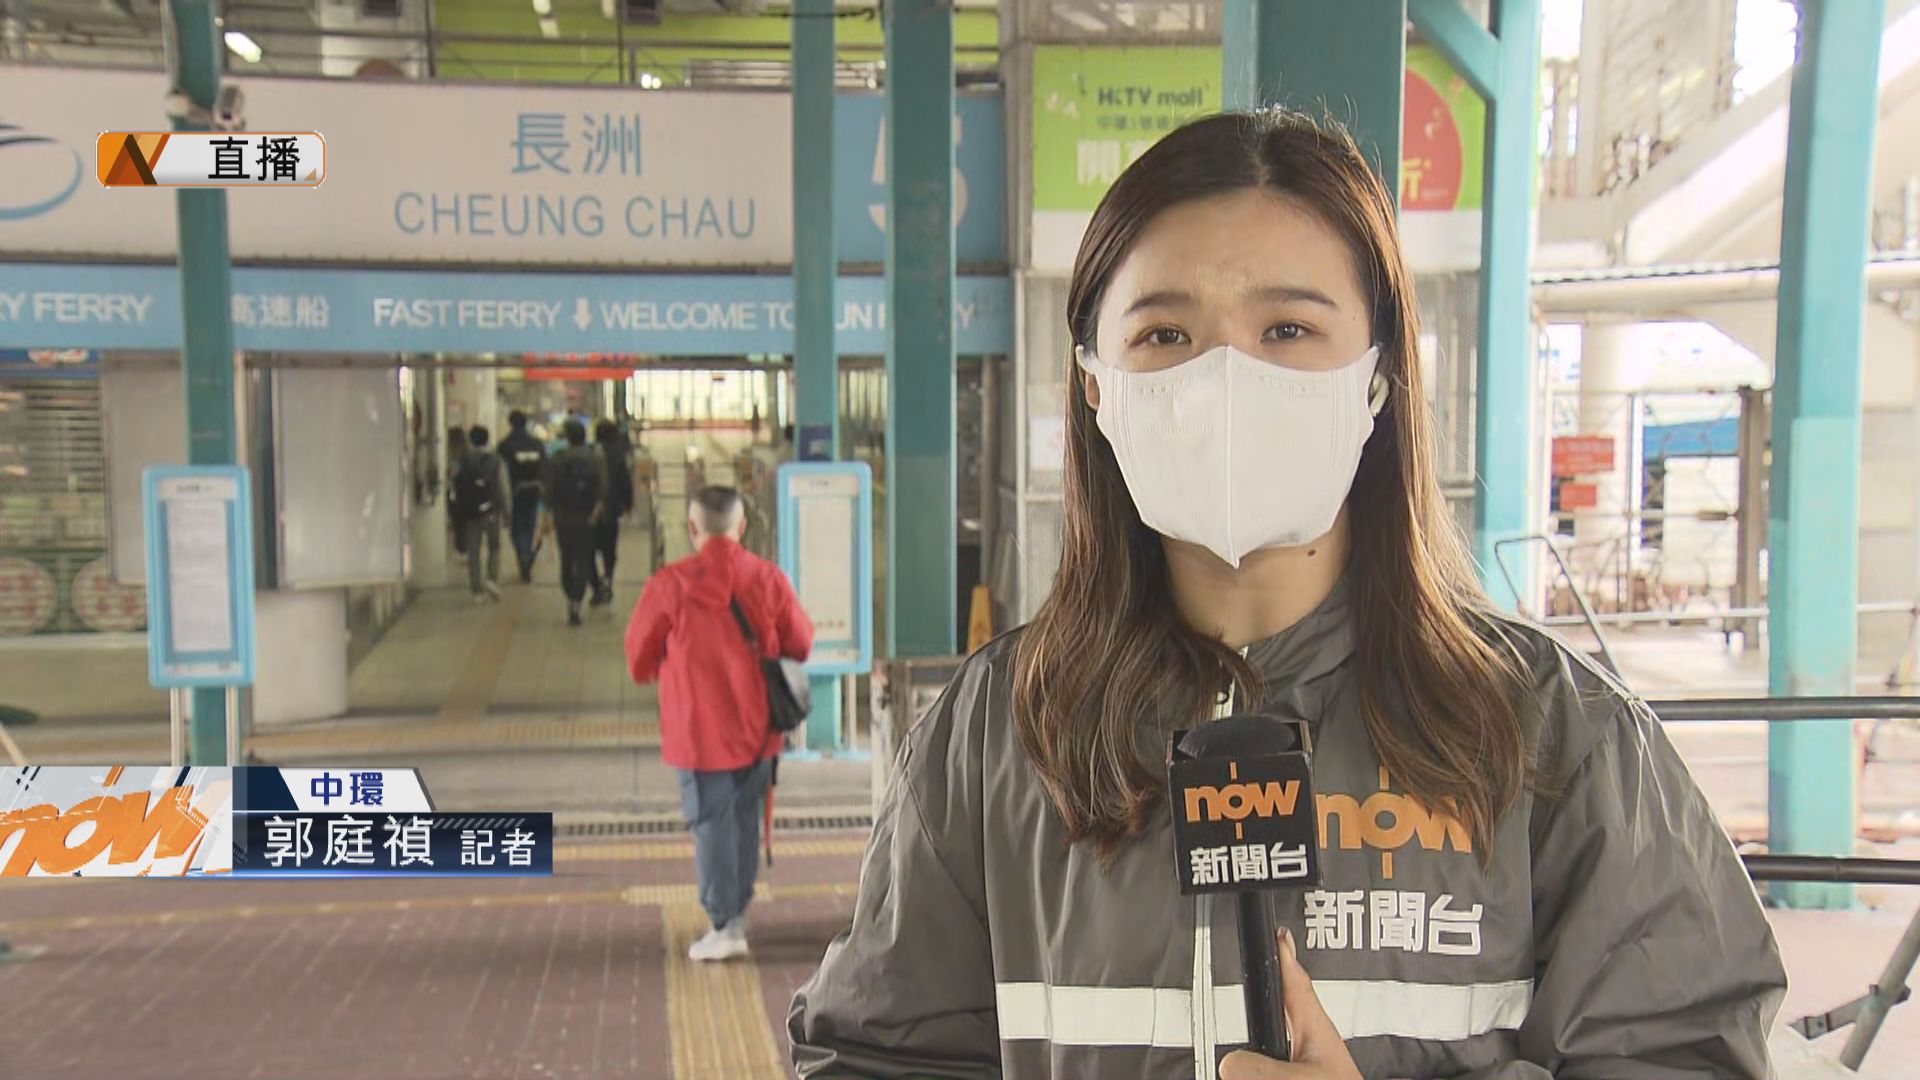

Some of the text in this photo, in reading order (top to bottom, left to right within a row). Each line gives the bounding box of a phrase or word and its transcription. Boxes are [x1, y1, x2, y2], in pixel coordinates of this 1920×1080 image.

[511, 112, 642, 176] 長洲
[394, 192, 756, 238] CHEUNG CHAU
[33, 292, 153, 323] FERRY
[373, 298, 452, 327] FAST
[458, 300, 561, 329] FERRY
[602, 301, 758, 330] WELCOME
[1184, 780, 1300, 823] now
[1315, 792, 1473, 853] now
[1190, 842, 1309, 885] 新聞台
[1304, 890, 1483, 955] 新聞台
